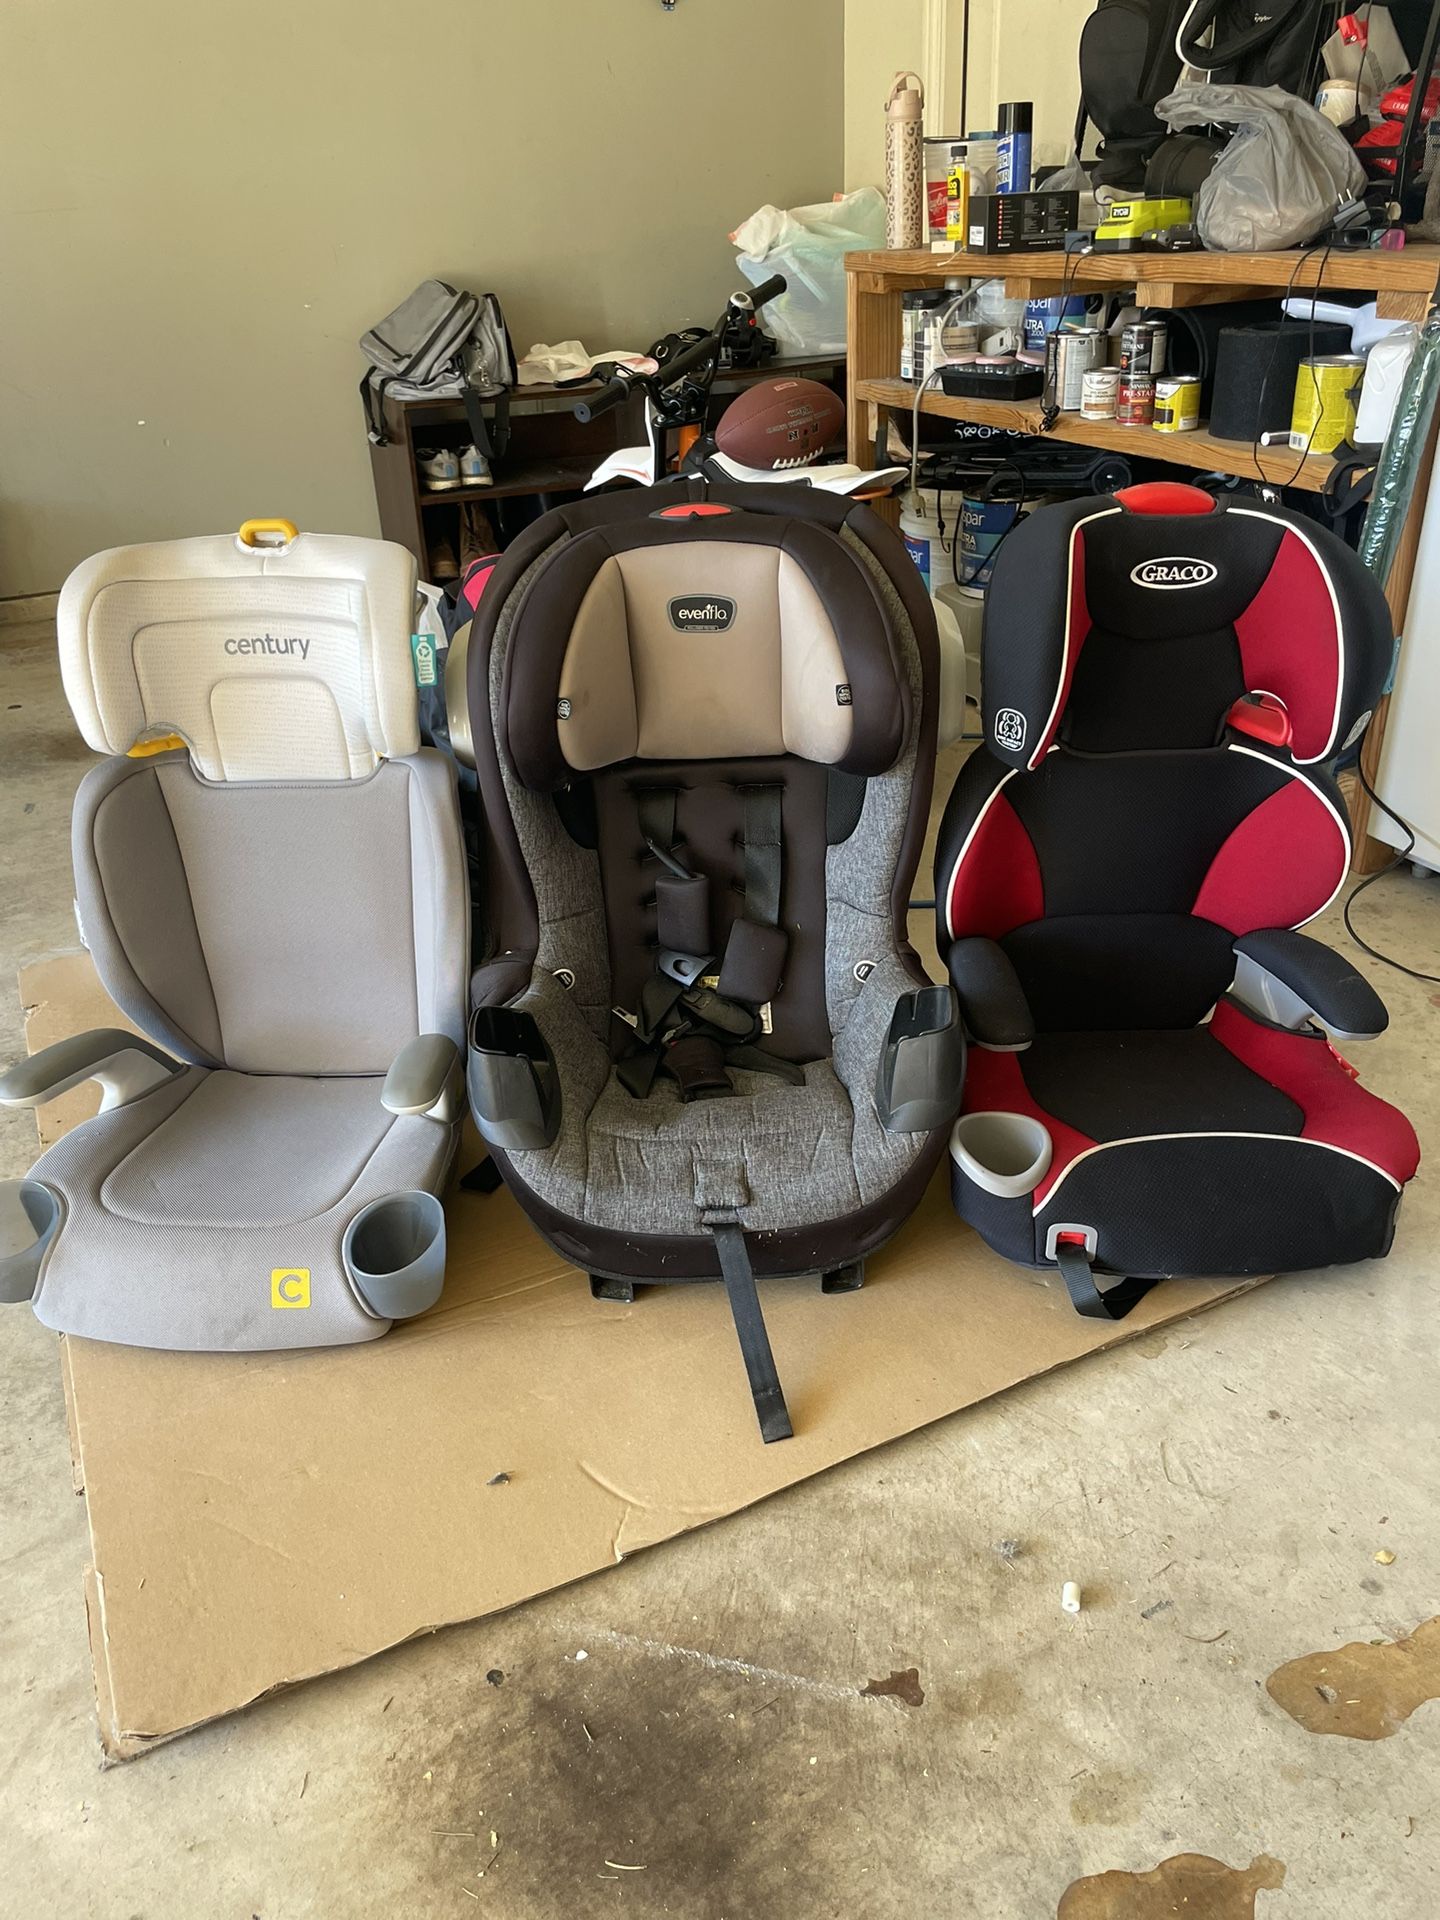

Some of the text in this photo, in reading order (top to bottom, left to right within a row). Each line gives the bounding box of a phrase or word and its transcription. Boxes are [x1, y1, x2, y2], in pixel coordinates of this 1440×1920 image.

[1113, 207, 1129, 217] RYOBI
[963, 512, 986, 526] spar
[1141, 565, 1208, 582] GRACO
[679, 603, 727, 620] evenflo
[224, 633, 310, 660] century
